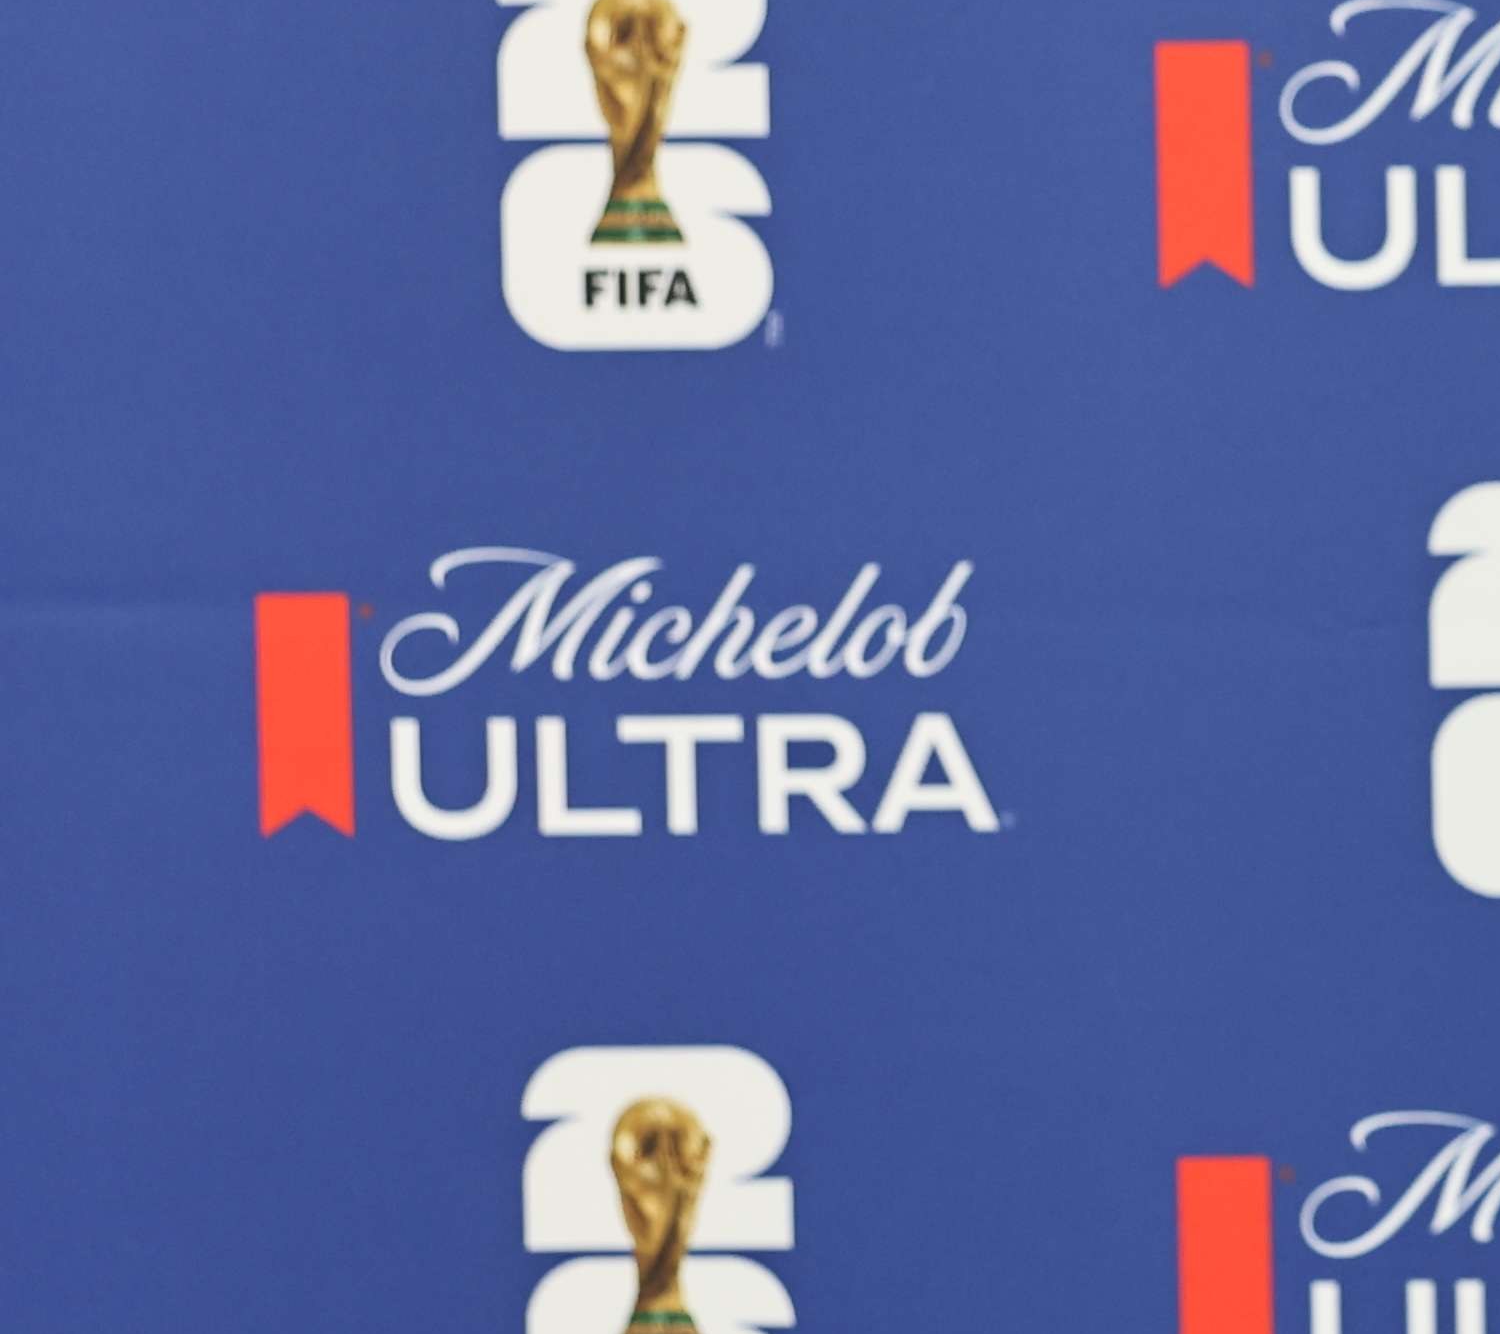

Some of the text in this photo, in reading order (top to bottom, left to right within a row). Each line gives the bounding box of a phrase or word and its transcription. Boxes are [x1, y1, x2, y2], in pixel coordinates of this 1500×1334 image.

[583, 268, 699, 308] FIFA
[378, 545, 974, 697] Michelob
[388, 711, 1001, 842] ULTRA
